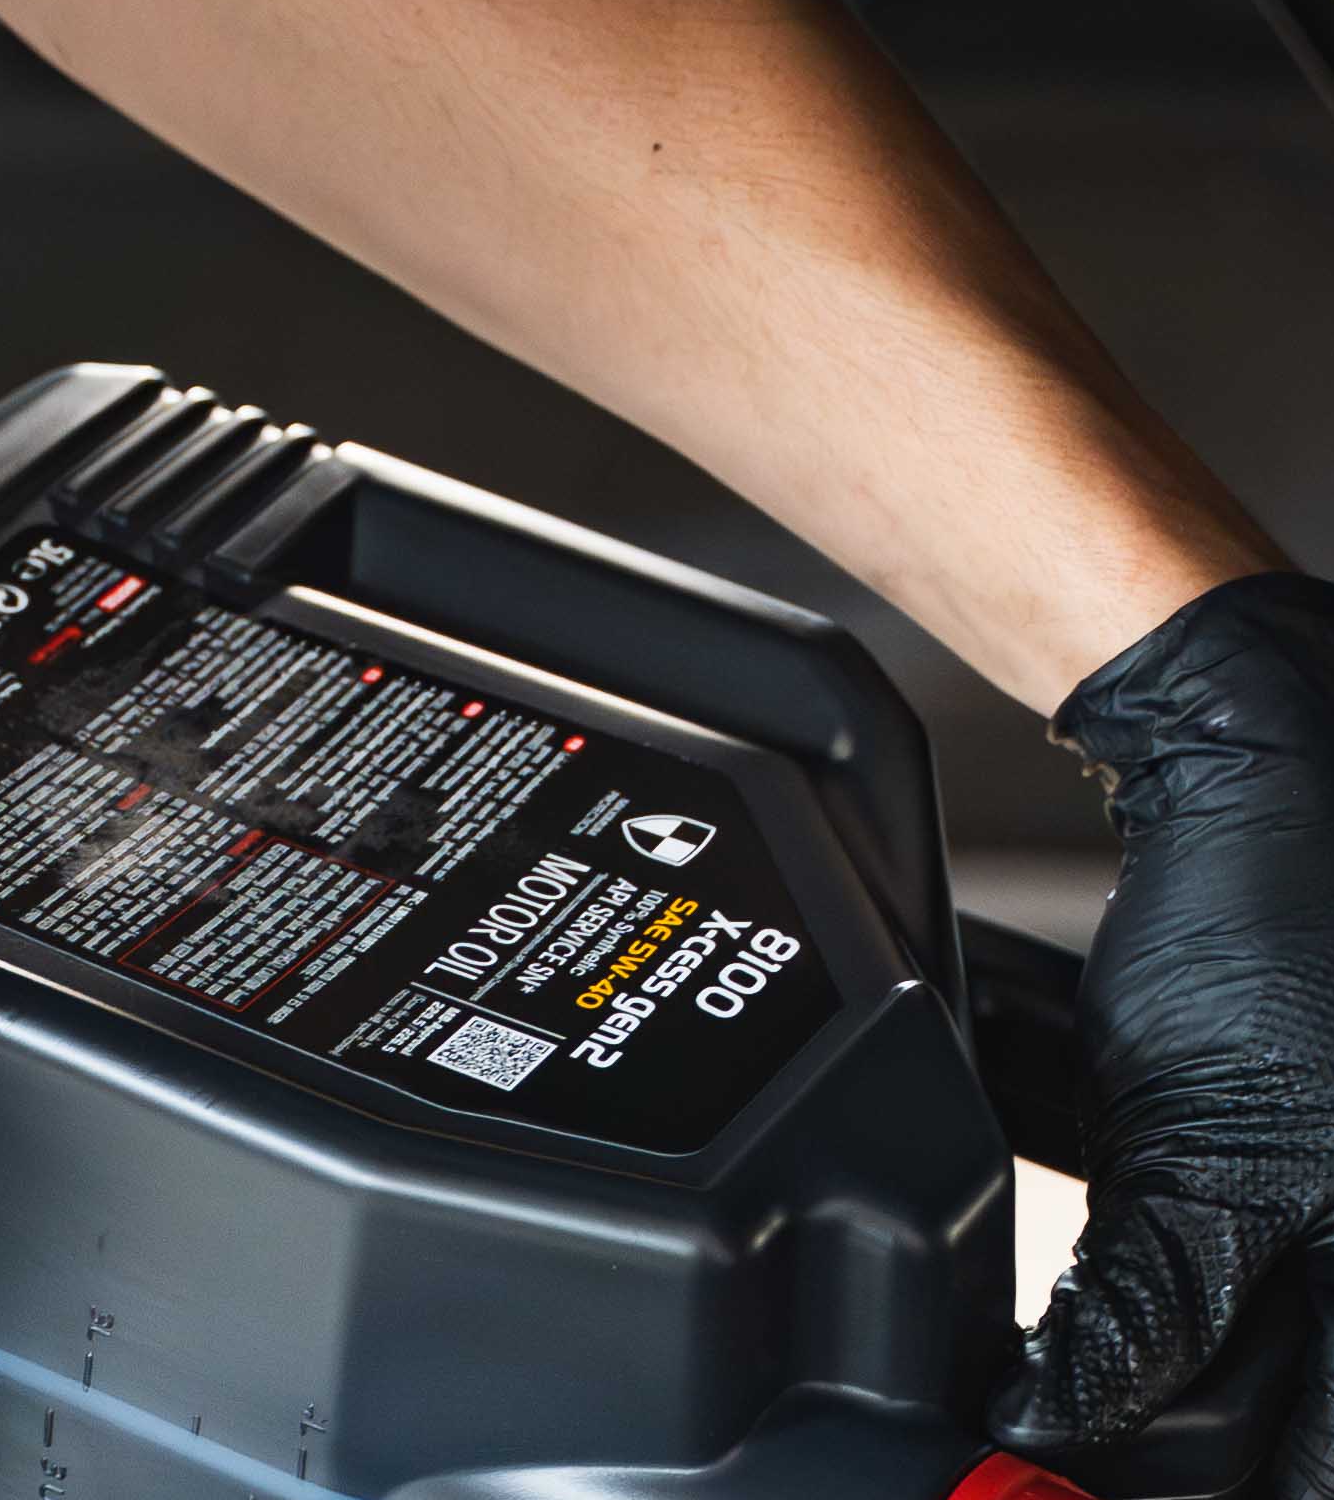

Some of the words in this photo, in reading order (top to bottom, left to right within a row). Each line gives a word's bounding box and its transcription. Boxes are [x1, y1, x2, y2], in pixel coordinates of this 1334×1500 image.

[468, 853, 591, 944] MOTOR
[598, 878, 637, 906] API
[624, 890, 668, 920] 100%
[643, 898, 698, 940] SAE
[424, 943, 498, 980] OIL
[539, 904, 614, 965] SERVICE
[570, 922, 634, 976] Synthetic
[641, 910, 752, 997] X-cess
[576, 940, 658, 1008] 5W-40
[696, 929, 800, 1018] 8100
[570, 993, 655, 1068] gen2
